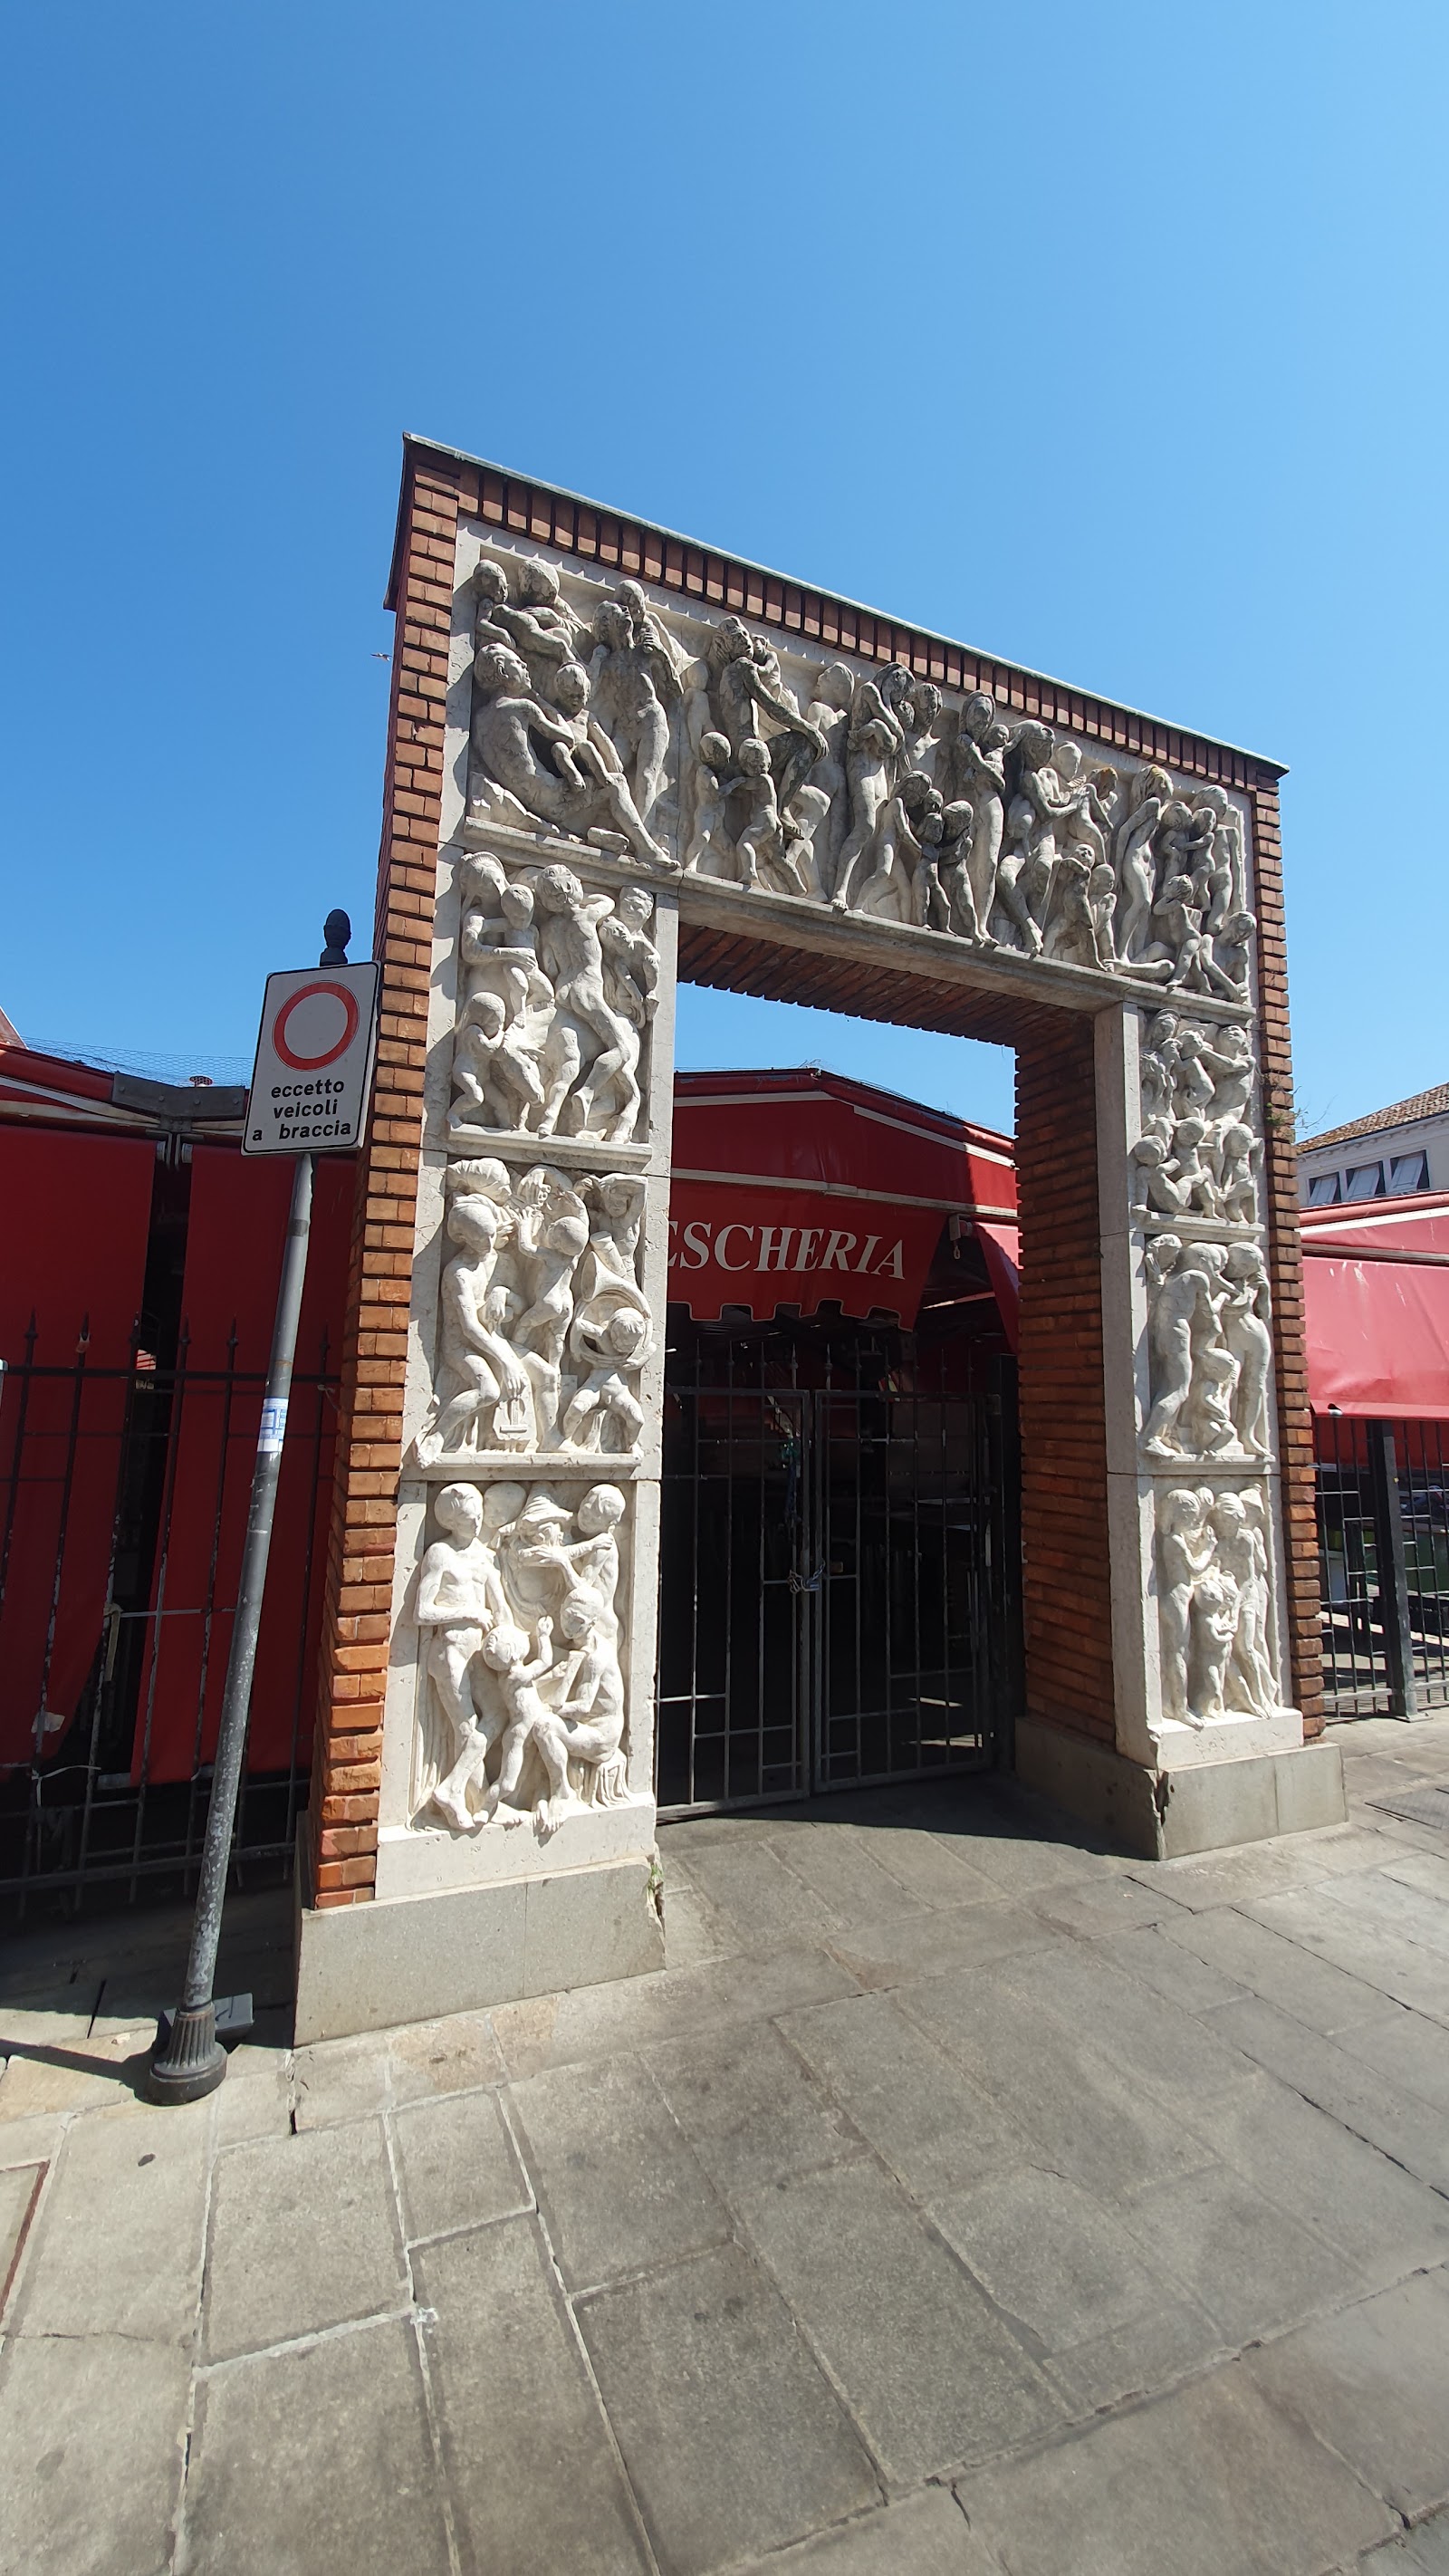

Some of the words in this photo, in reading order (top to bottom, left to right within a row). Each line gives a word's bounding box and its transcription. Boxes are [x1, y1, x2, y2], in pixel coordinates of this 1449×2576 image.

[271, 1078, 345, 1099] eccetto
[273, 1099, 338, 1119] veicoli
[252, 1129, 263, 1141] a
[279, 1120, 351, 1140] braccia
[668, 1220, 906, 1280] SCHERIA
